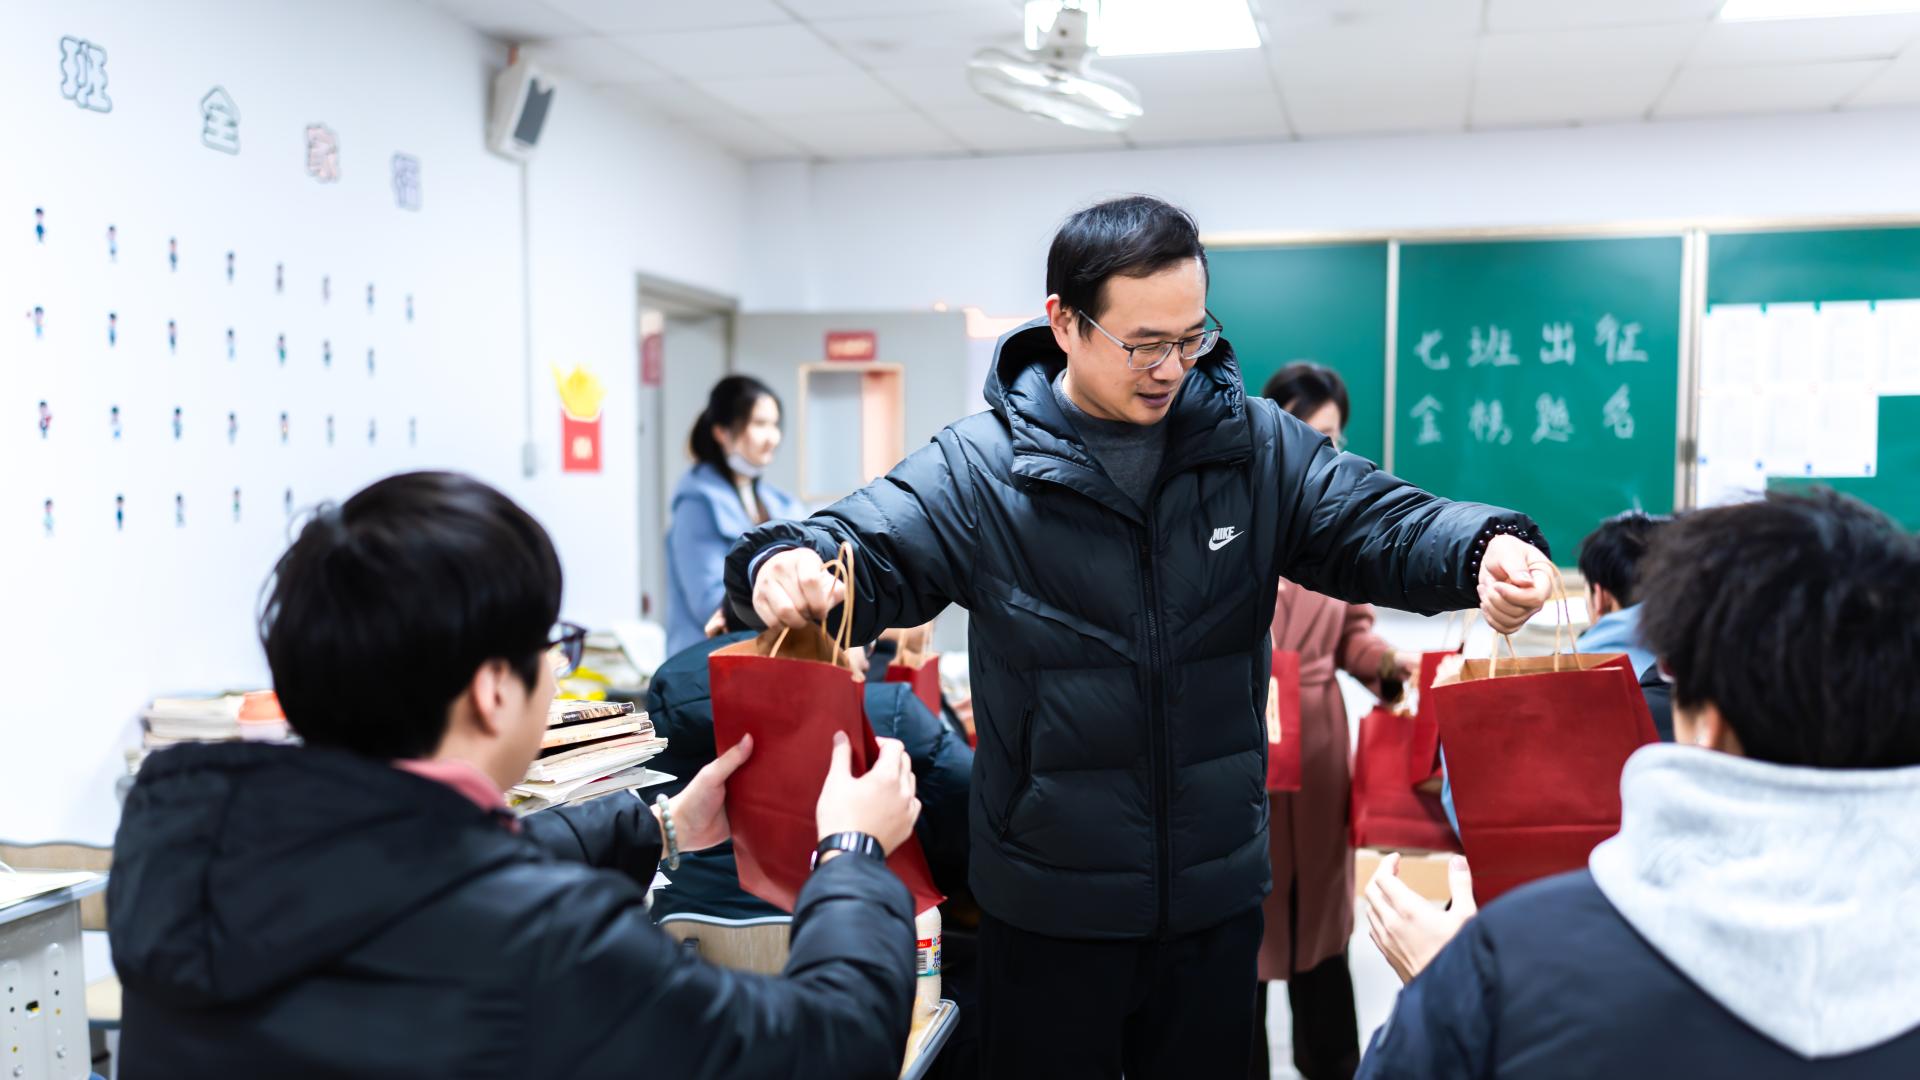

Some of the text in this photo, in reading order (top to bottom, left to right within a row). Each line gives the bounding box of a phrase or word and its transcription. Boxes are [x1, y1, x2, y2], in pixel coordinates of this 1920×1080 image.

[1413, 313, 1649, 370] 七班出征
[1410, 384, 1635, 445] 金榜题名
[1213, 526, 1235, 541] NIKE
